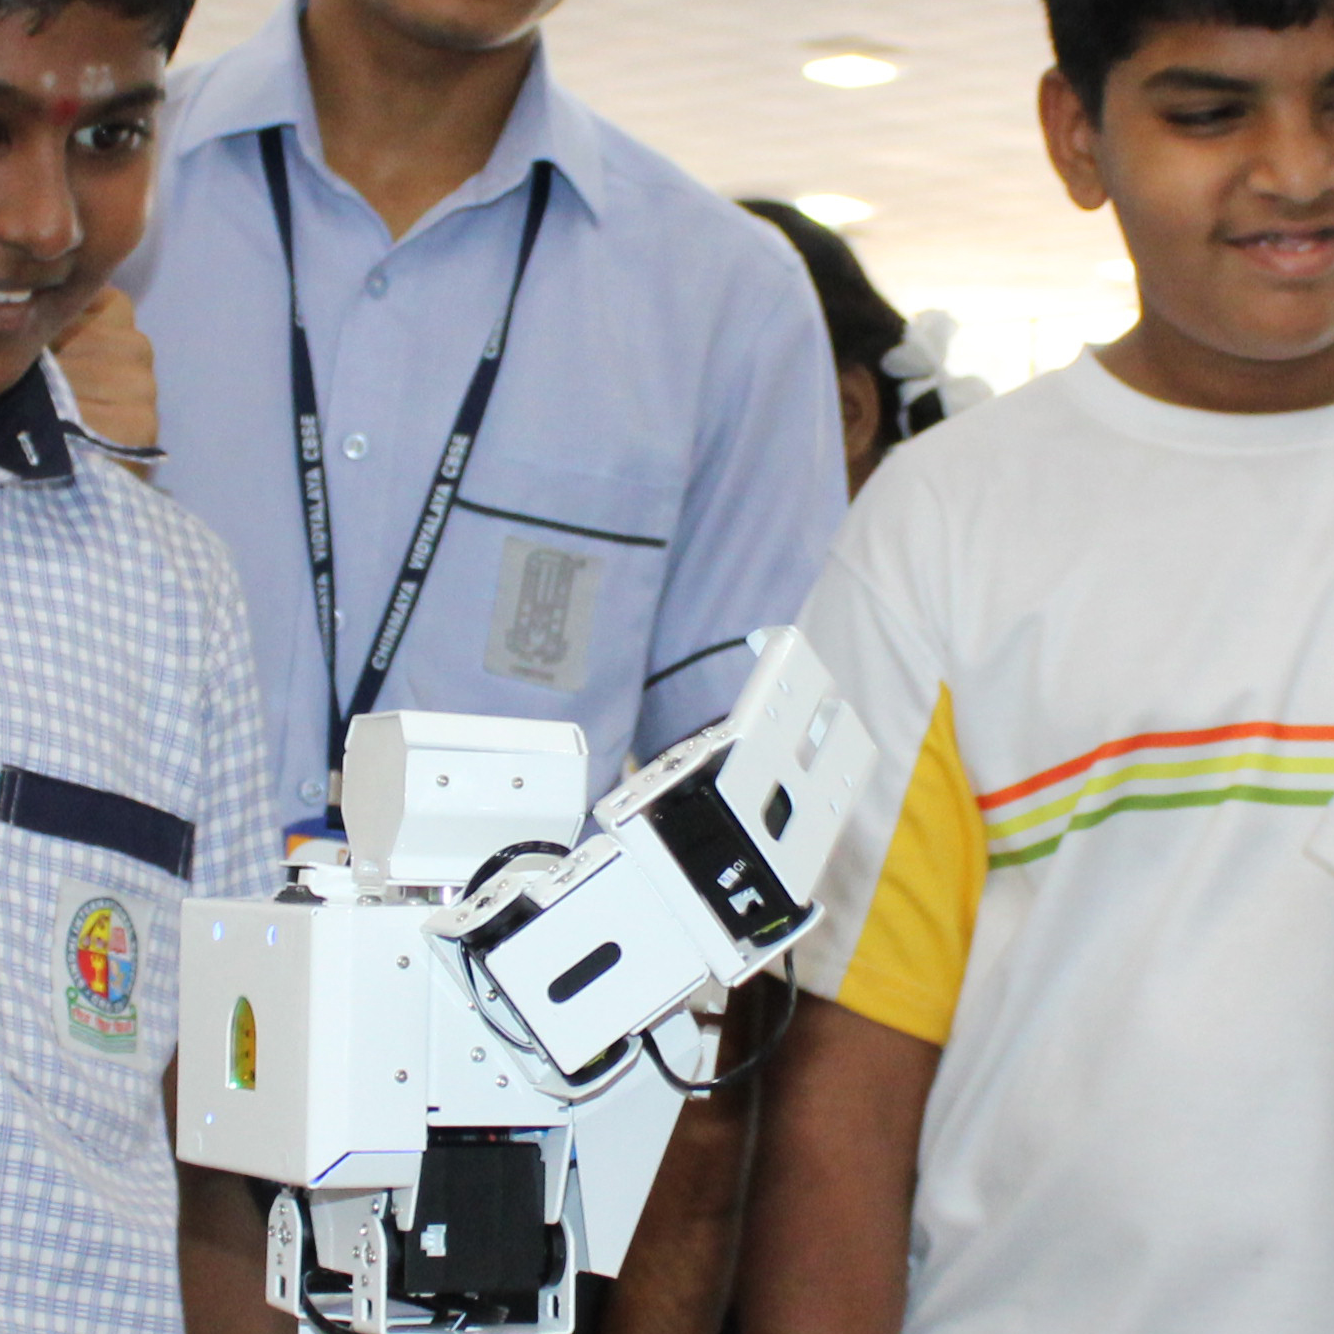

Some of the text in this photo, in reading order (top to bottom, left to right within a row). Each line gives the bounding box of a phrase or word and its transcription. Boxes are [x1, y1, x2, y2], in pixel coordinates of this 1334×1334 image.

[301, 414, 319, 461] CBSE
[301, 467, 328, 561] VIDYALAYA
[370, 433, 470, 672] CHINMAYA VIDYALAYA CBSE
[732, 858, 747, 873] ID
